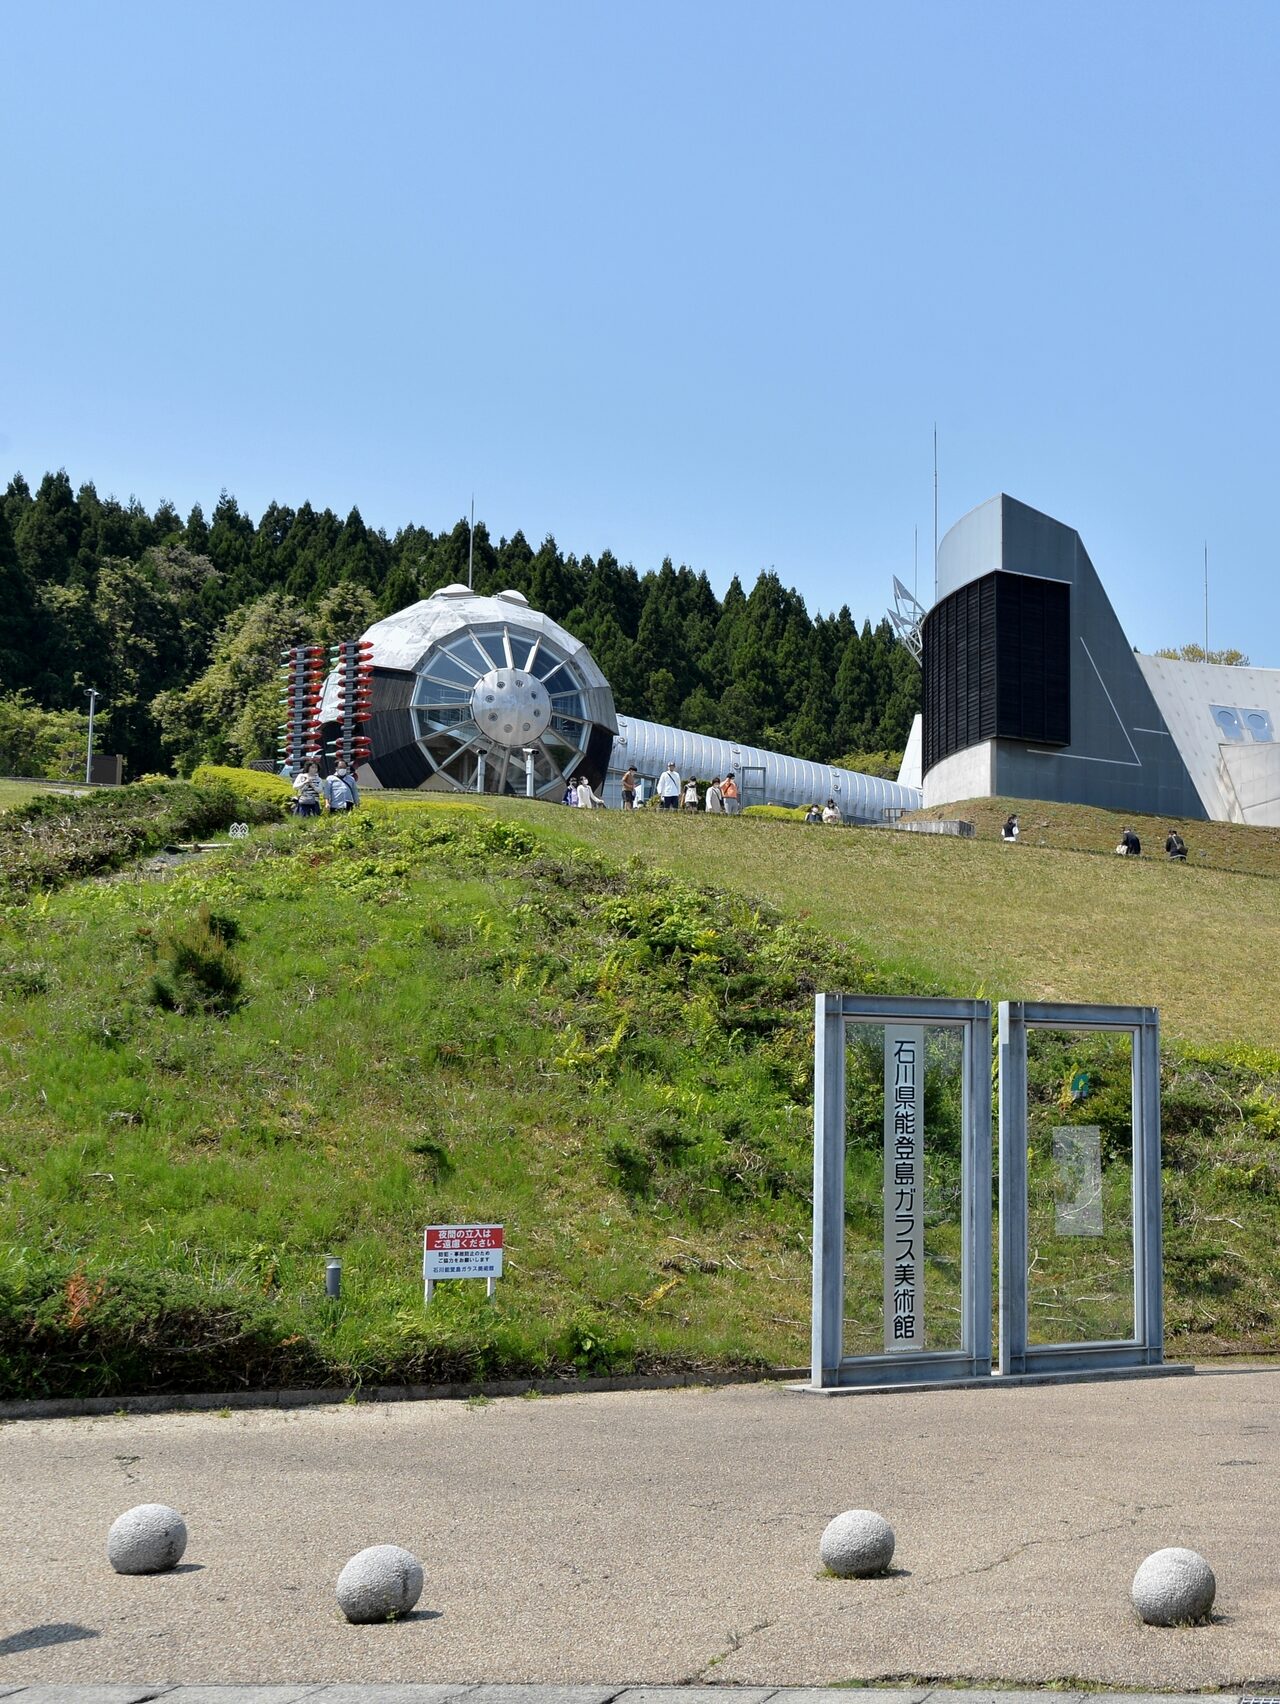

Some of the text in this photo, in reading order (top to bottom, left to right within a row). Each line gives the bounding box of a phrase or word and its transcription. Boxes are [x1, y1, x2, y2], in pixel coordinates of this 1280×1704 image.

[438, 1230, 491, 1239] 夜間の立入は
[893, 1040, 916, 1340] 石川県能登島ガラス美術館
